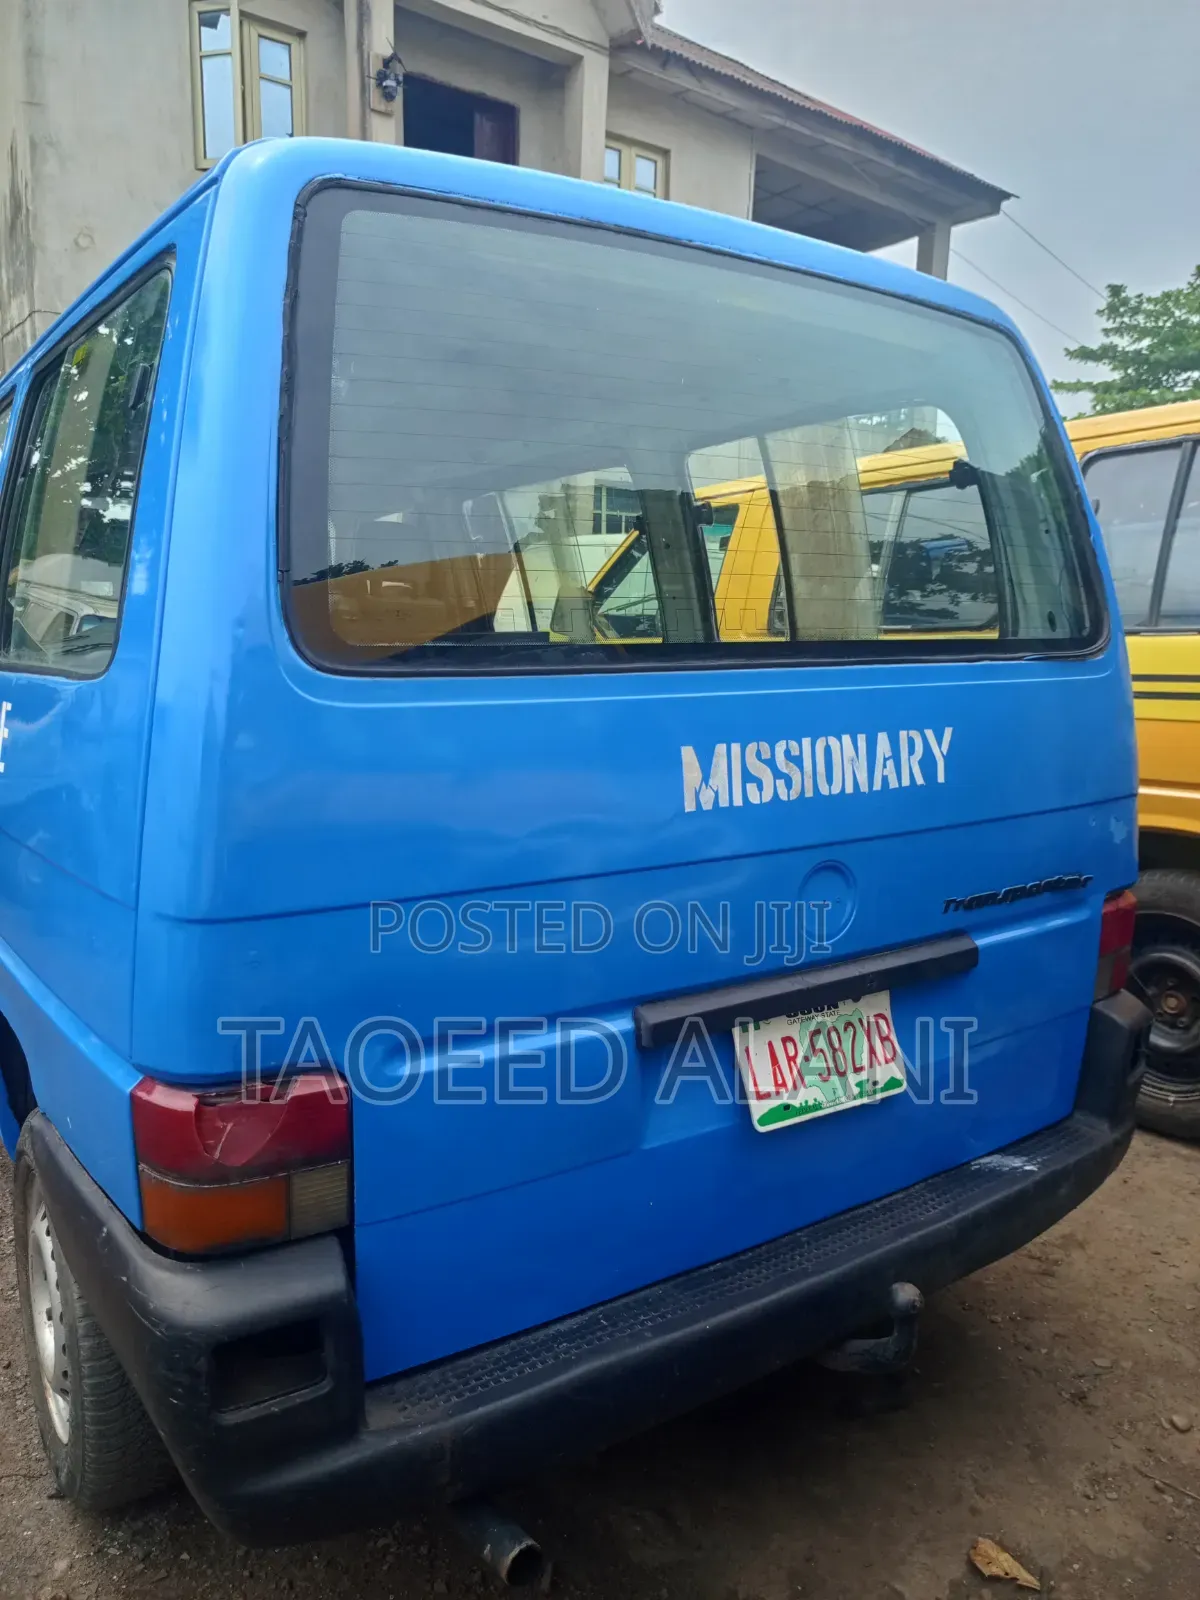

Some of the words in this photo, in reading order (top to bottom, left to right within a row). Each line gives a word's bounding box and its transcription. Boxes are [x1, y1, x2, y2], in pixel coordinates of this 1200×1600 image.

[680, 727, 953, 812] MISSIONARY
[786, 1014, 820, 1026] GATEWAY
[821, 1010, 841, 1019] STATE
